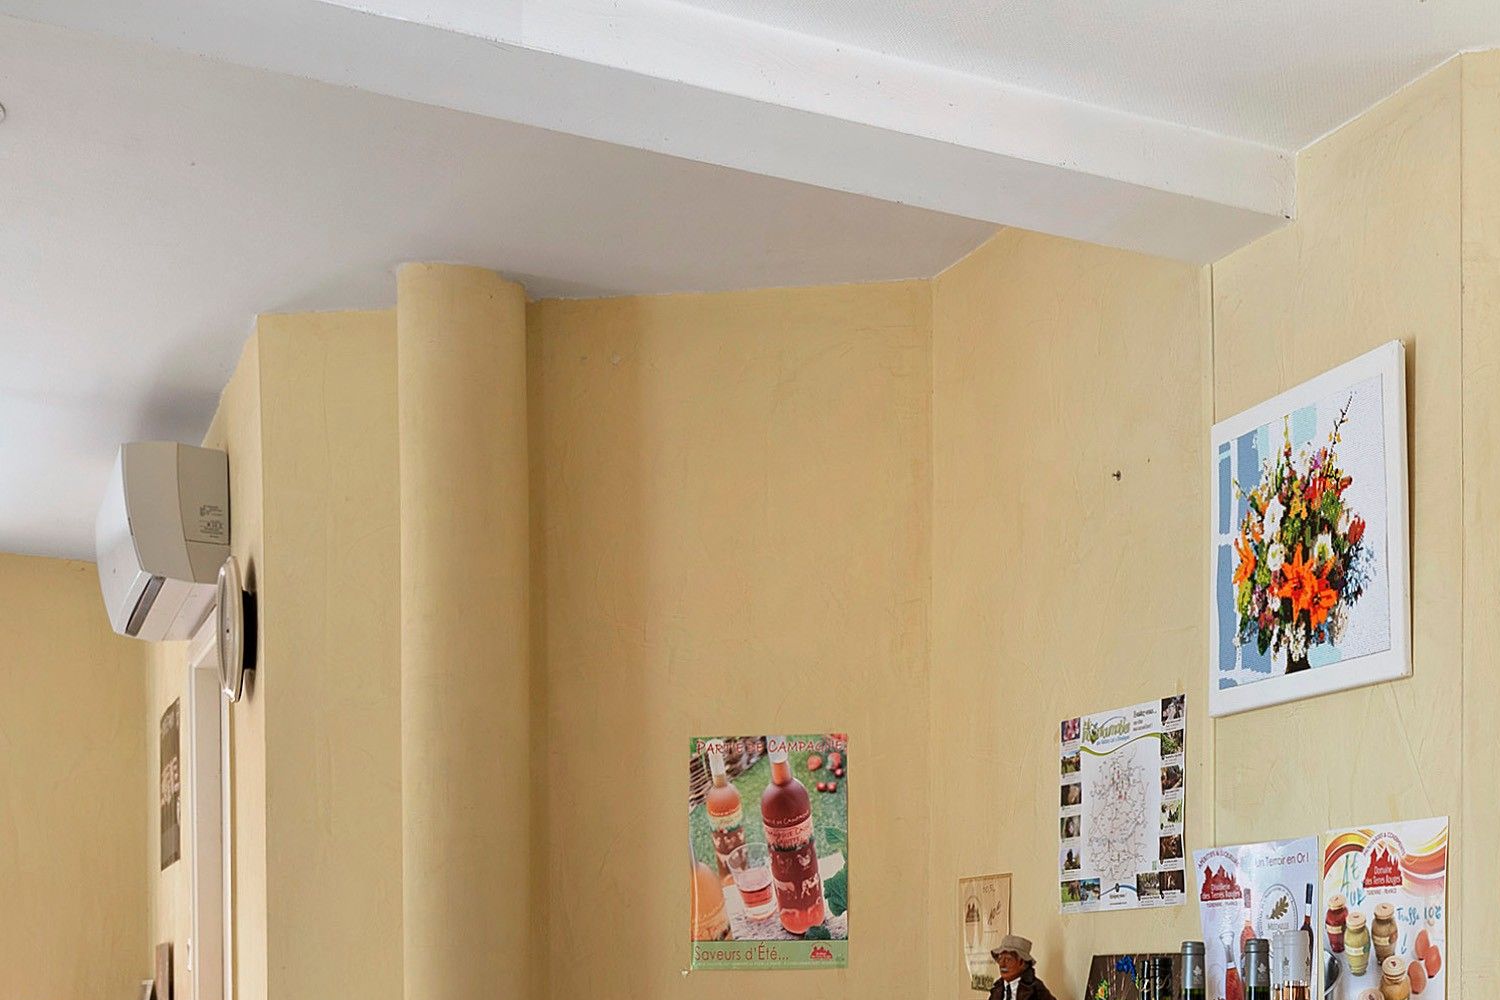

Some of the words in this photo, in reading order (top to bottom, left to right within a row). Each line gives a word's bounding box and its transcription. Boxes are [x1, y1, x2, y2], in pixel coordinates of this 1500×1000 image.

[696, 740, 743, 753] PARTIE
[747, 740, 763, 752] DE
[768, 739, 843, 753] CAMPAGNE
[1286, 856, 1296, 865] en
[1373, 875, 1385, 884] Terres
[1386, 874, 1401, 886] Rouges
[695, 946, 741, 961] Saveurs
